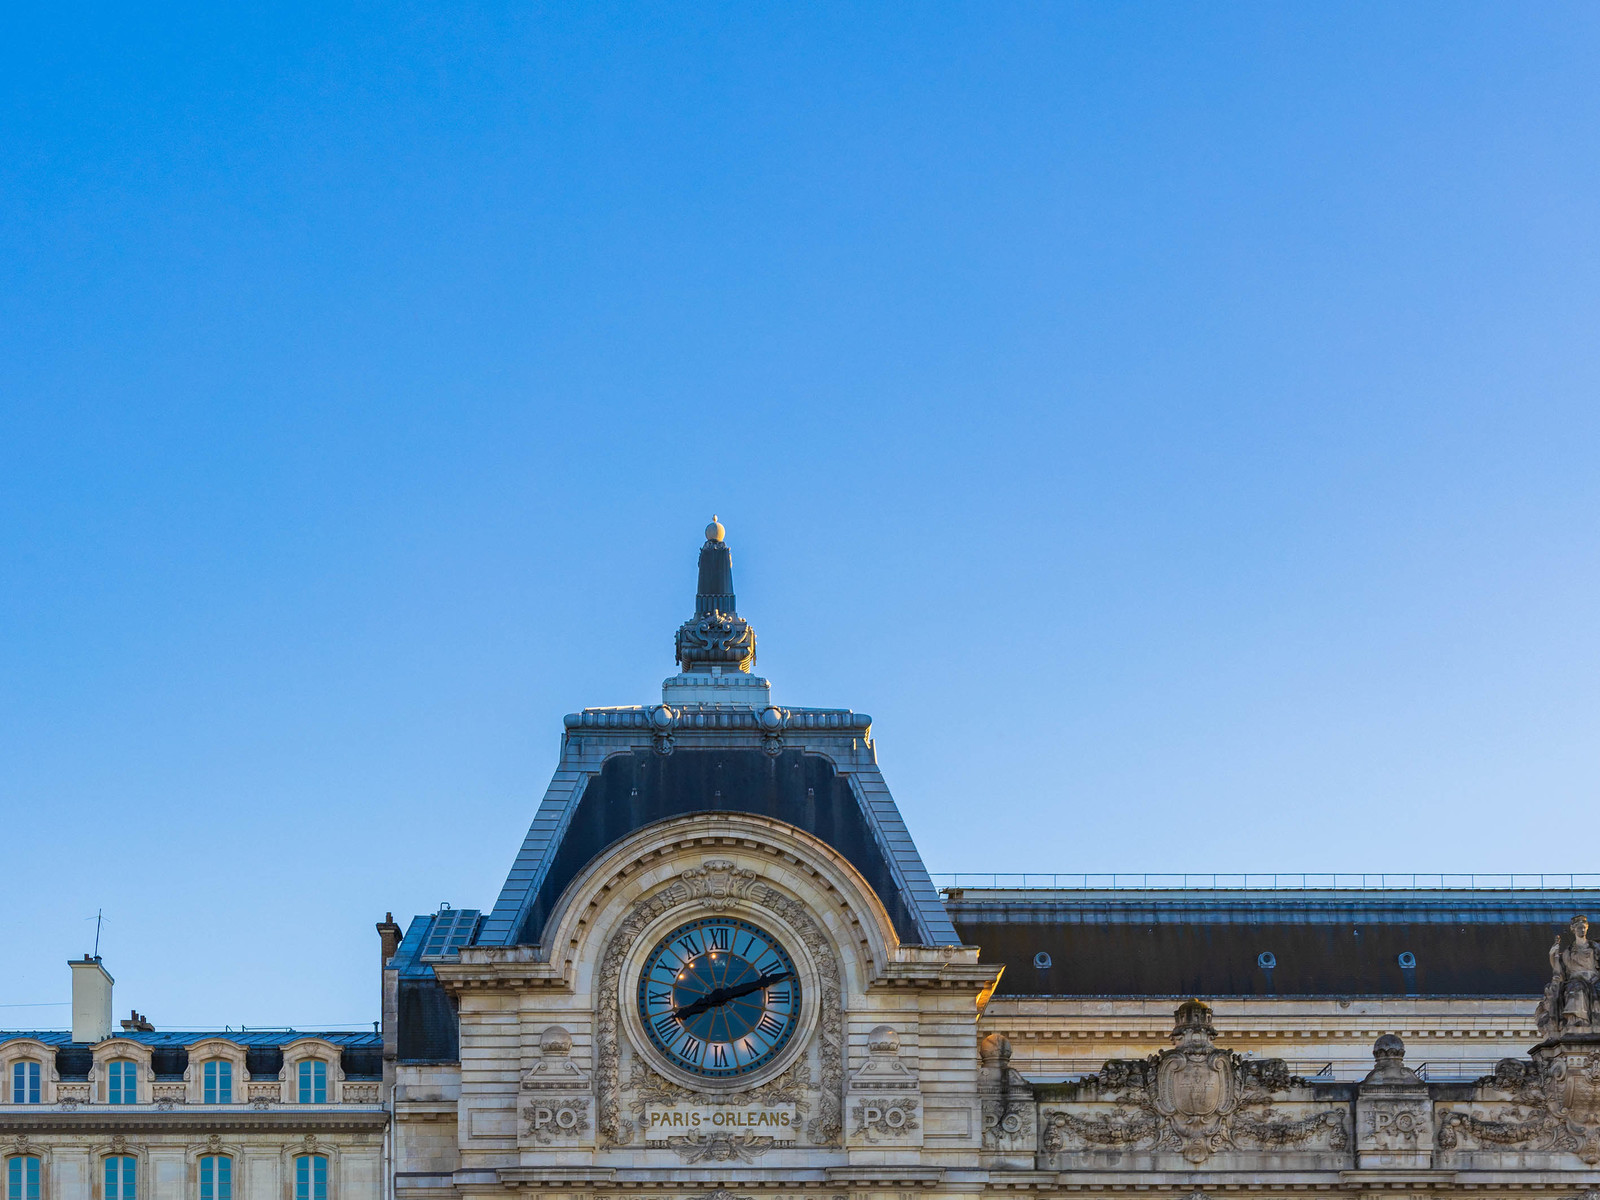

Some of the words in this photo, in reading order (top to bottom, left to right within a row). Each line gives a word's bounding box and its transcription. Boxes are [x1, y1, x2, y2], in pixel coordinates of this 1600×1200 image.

[677, 934, 701, 960] XI
[708, 928, 729, 950] XII
[742, 936, 756, 957] I
[655, 959, 681, 978] X
[767, 990, 790, 1004] III
[757, 1014, 785, 1040] IIII
[678, 1036, 702, 1063] VII
[713, 1045, 730, 1067] VI
[744, 1038, 760, 1060] V
[535, 1107, 579, 1129] PO
[650, 1111, 791, 1127] PARIS-ORLEANS
[863, 1106, 908, 1128] PO
[1375, 1111, 1417, 1132] PO
